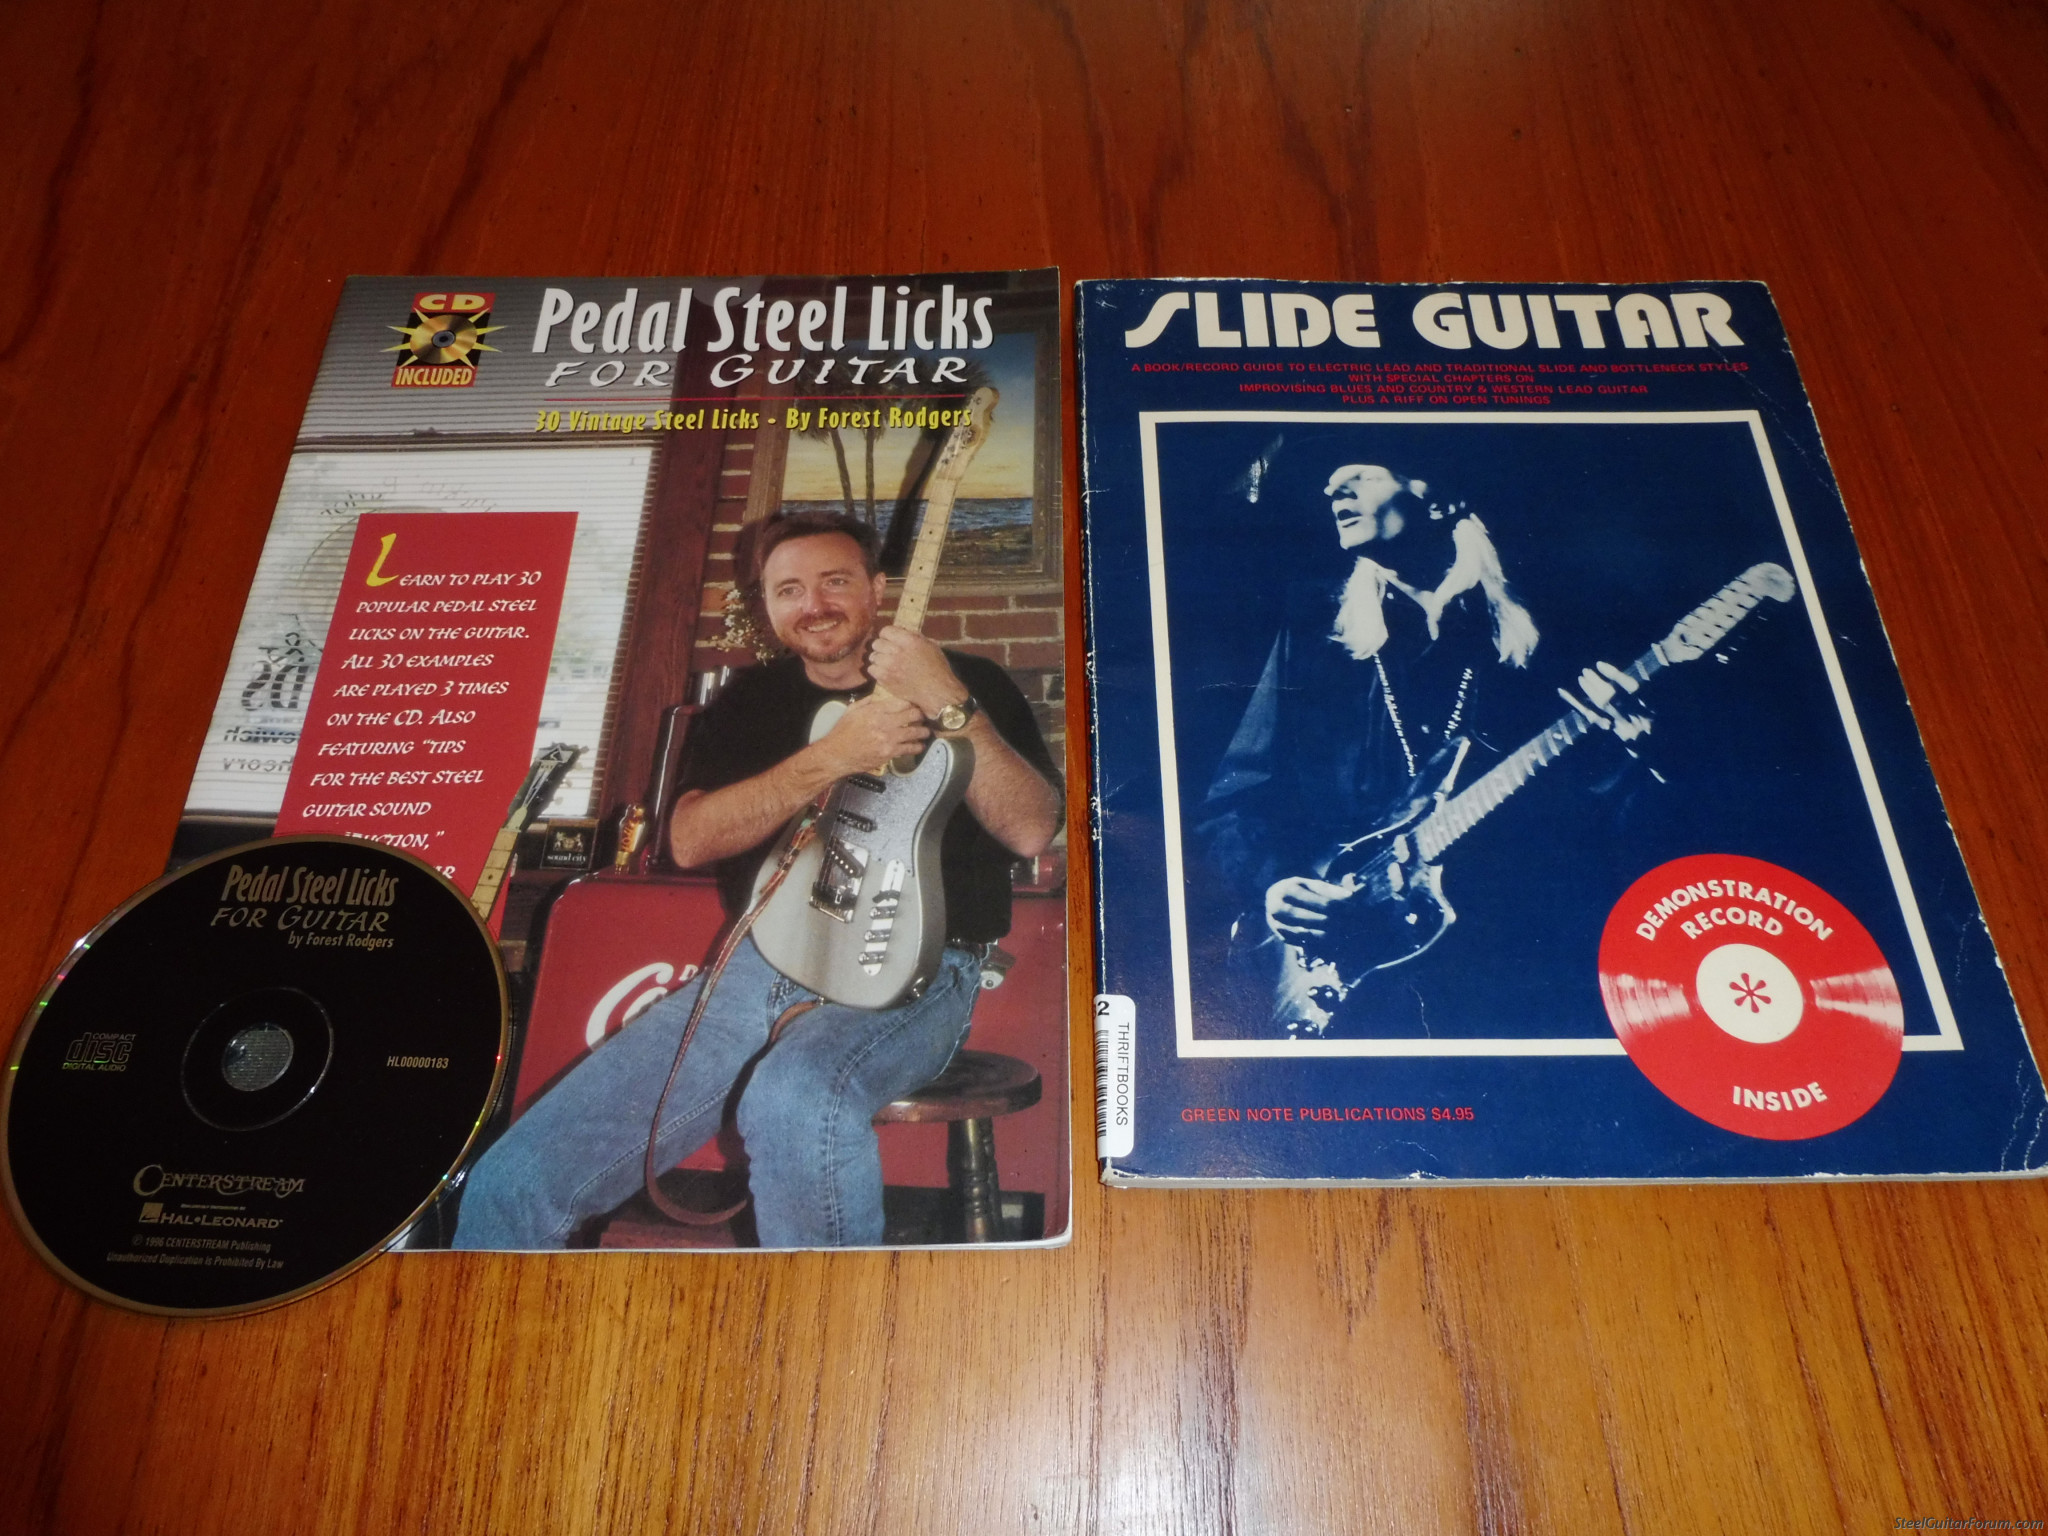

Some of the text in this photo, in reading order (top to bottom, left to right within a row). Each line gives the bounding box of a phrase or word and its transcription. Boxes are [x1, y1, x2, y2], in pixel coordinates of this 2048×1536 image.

[418, 294, 486, 311] CD
[532, 284, 994, 355] Pedal Steel Licks
[1125, 291, 1745, 350] SLIDE GUITAR
[395, 367, 474, 387] INCLUDED
[544, 354, 969, 389] FOR GUITAR
[1131, 362, 1749, 374] A BOOK/RECORD GUIDE TO ELECTRIC LEAD AND TRADITIONAL SLIDE AND BOTTLENECK STYLES
[1347, 373, 1535, 384] WITH SPECIAL CHAPTERS ON
[1239, 383, 1649, 395] IMPROVISING BLUES AND COUNTRY & WESTERN LEAD GUITAR
[1341, 394, 1551, 405] PLUS A RIFF ON OPEN TUNINGS
[534, 410, 562, 433] 30
[569, 409, 647, 435] Vintage
[652, 409, 705, 431] Steel
[711, 408, 760, 431] Licks
[785, 407, 811, 432] By
[818, 407, 882, 430] Forest
[889, 405, 972, 431] Rodgers
[366, 533, 542, 587] LEARN TO PLAY 30
[356, 599, 539, 614] POPULAR PEDAL STEEL
[348, 626, 531, 641] LICKS ON THE GUITAR.
[340, 652, 496, 670] ALL 30 EXAMPLES
[332, 681, 511, 698] ARE PLAYED 3 TIMES
[326, 708, 477, 728] ON THE CD. ALSO
[317, 740, 415, 757] FEATURING
[310, 769, 485, 787] FOR THE BEST STEEL
[302, 801, 433, 819] GUITAR SOUND
[221, 864, 290, 905] Pedal
[286, 866, 348, 905] Steel
[345, 867, 399, 907] Licks
[210, 904, 390, 932] FOR GUITAR
[1635, 878, 1835, 942] DEMONSTRATION
[1679, 906, 1784, 940] RECORD
[287, 930, 395, 951] by Forest Rodgers
[92, 1032, 137, 1042] COMPACT
[65, 1032, 133, 1064] disc
[62, 1062, 127, 1073] DIGITAL AUDIO
[386, 1055, 449, 1070] HL00000183
[1116, 1022, 1130, 1126] THRIFTBOOKS
[1732, 1081, 1828, 1112] INSIDE
[1181, 1107, 1241, 1123] GREEN
[1246, 1107, 1294, 1122] NOTE
[1299, 1106, 1426, 1121] PUBLICATIONS
[132, 1164, 306, 1199] CENTERSTREAM
[166, 1236, 229, 1250] CENTERSTREAM
[230, 1239, 272, 1254] Publishing
[106, 1251, 158, 1264] Unauthorized
[158, 1252, 203, 1266] Duplication
[213, 1256, 254, 1268] Prohibited
[254, 1258, 266, 1271] By
[266, 1259, 284, 1270] Law
